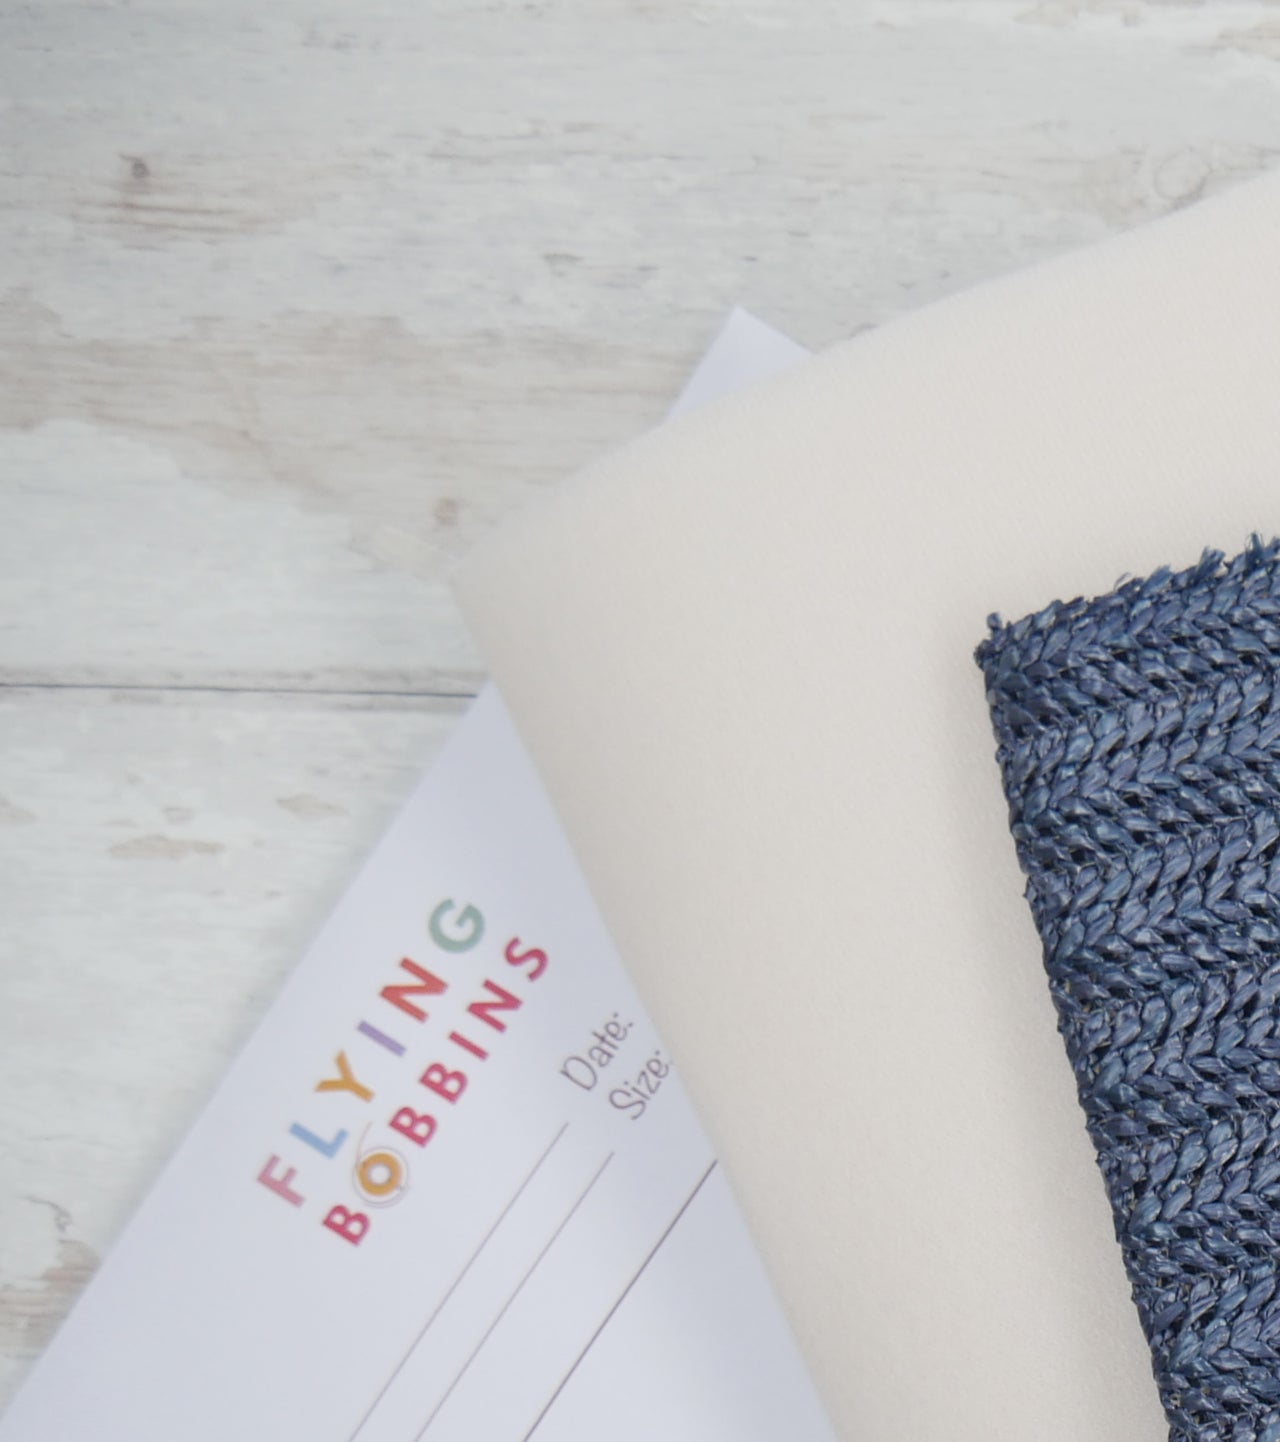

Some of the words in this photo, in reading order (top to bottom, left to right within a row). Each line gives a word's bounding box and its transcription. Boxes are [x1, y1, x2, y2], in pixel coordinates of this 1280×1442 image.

[256, 897, 486, 1208] FLYING
[321, 935, 549, 1247] BOBBINS
[559, 1011, 634, 1091] Date:
[608, 1049, 673, 1121] Size:
